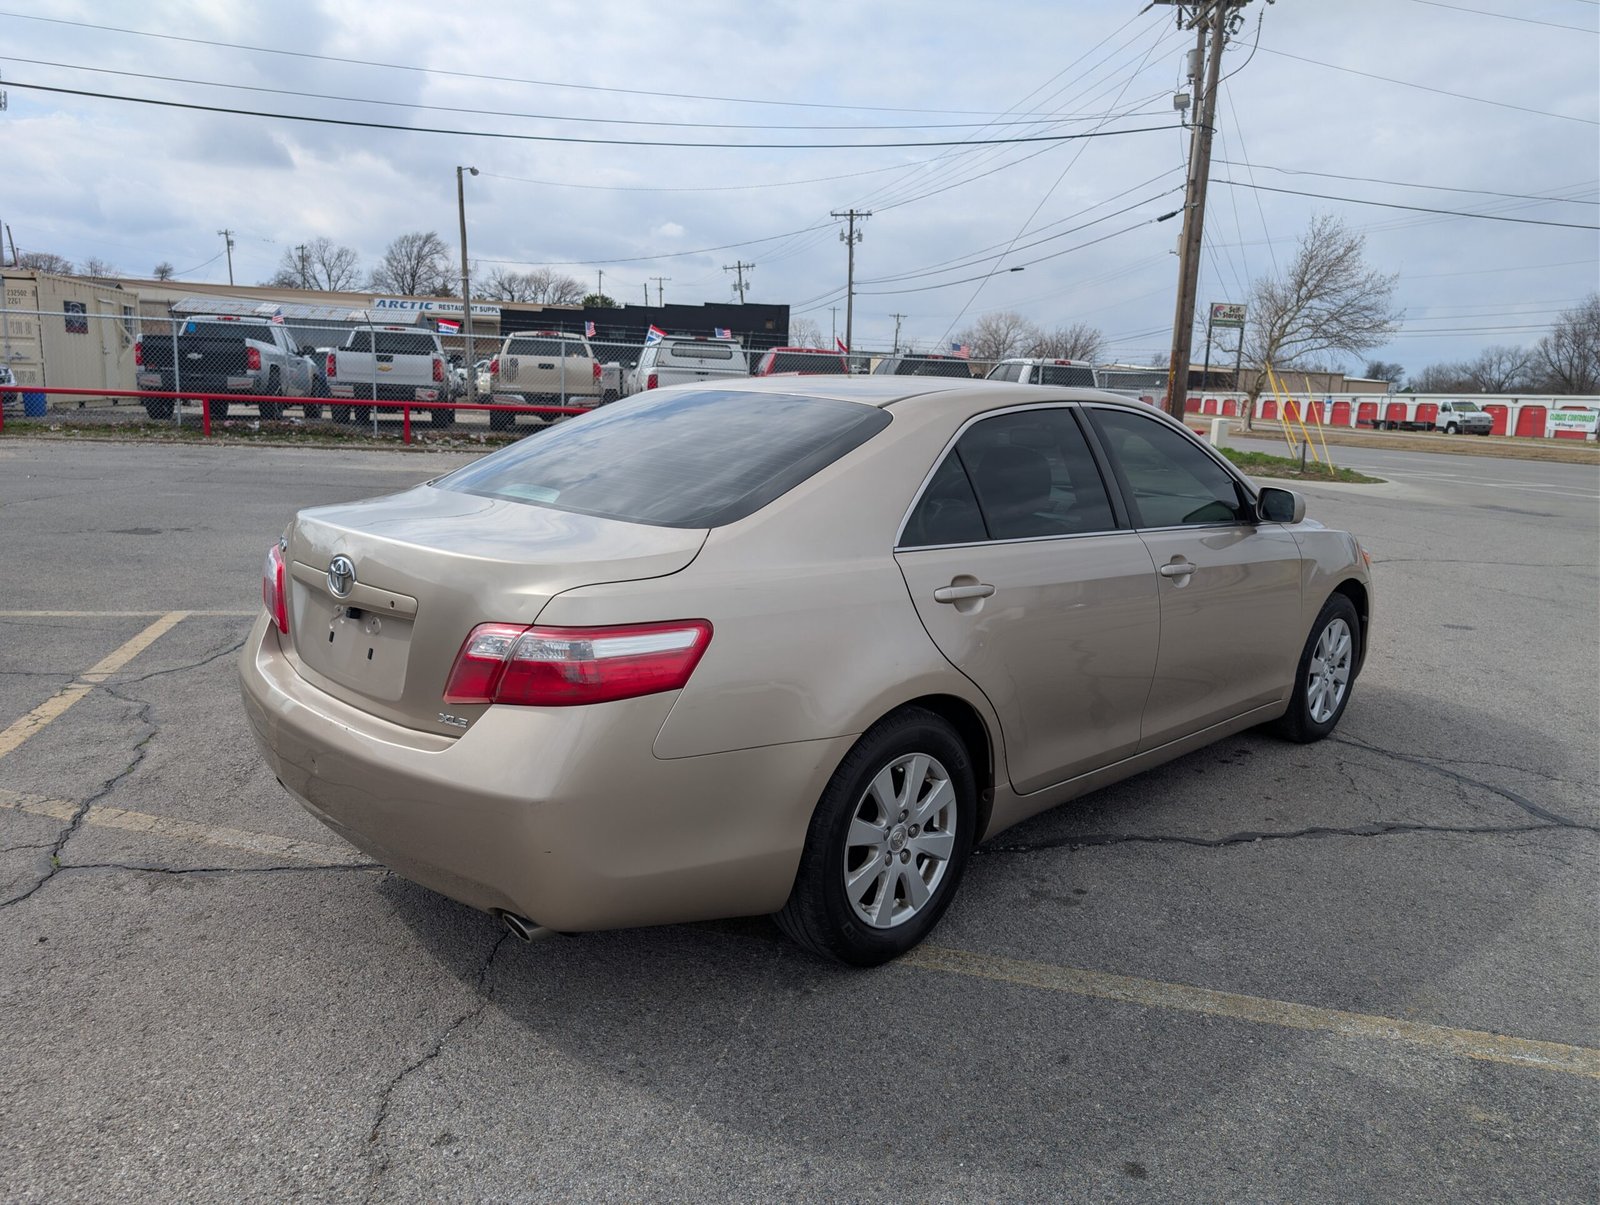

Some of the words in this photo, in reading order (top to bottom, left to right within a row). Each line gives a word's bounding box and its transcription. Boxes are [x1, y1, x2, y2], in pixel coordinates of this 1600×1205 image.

[376, 299, 433, 310] ARCTIC
[438, 303, 478, 312] RESTAUNT
[438, 712, 468, 728] XLE
